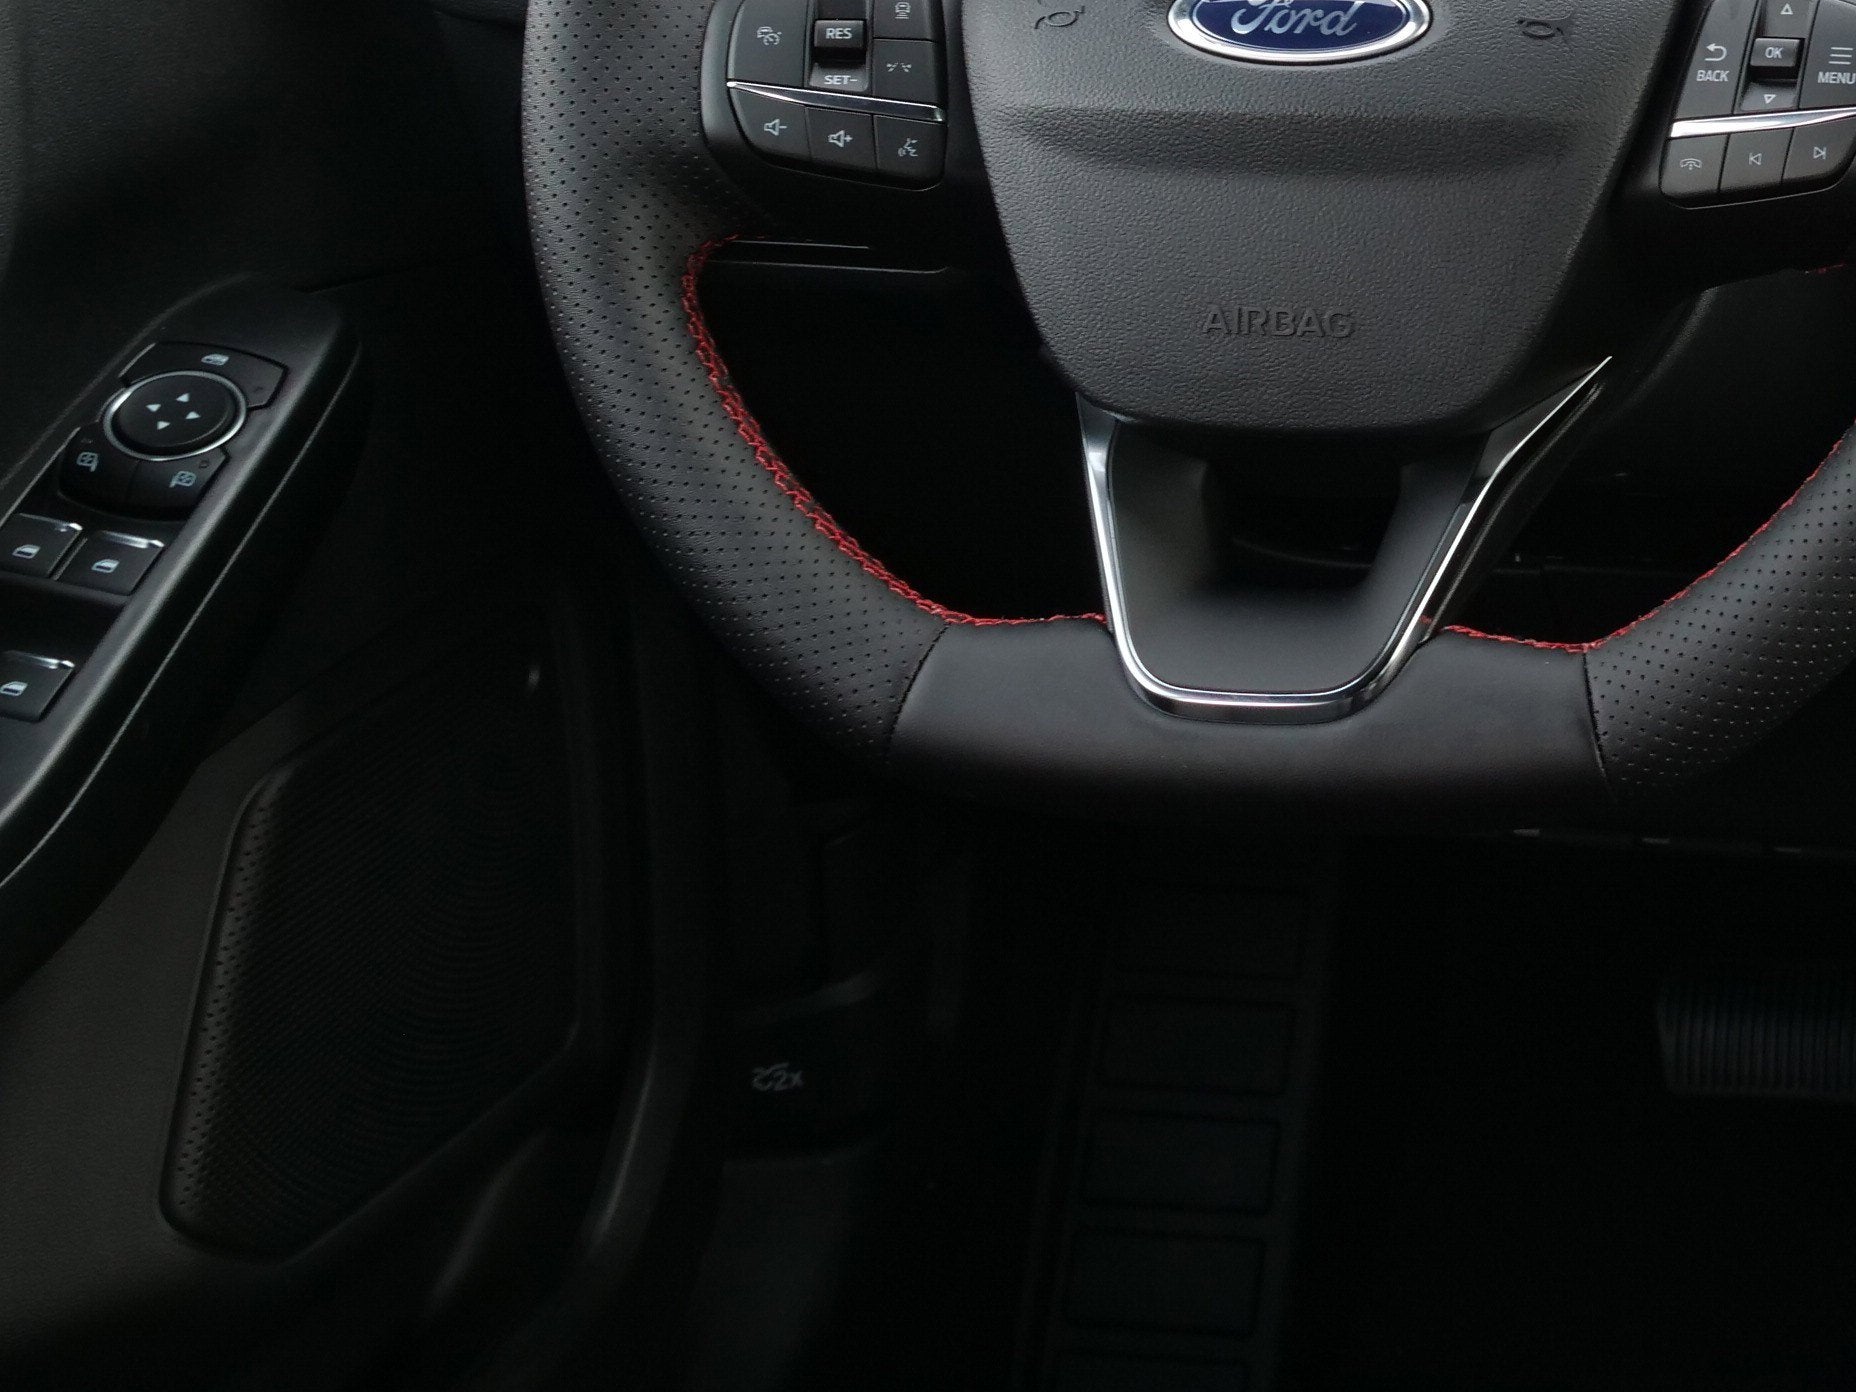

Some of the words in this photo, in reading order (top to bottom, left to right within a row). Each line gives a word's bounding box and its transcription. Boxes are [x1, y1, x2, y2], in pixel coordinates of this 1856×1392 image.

[825, 27, 853, 39] RES
[1765, 46, 1783, 59] OK
[1696, 69, 1730, 82] BACK
[1817, 71, 1856, 85] MENU
[1201, 304, 1355, 339] AIRBAG
